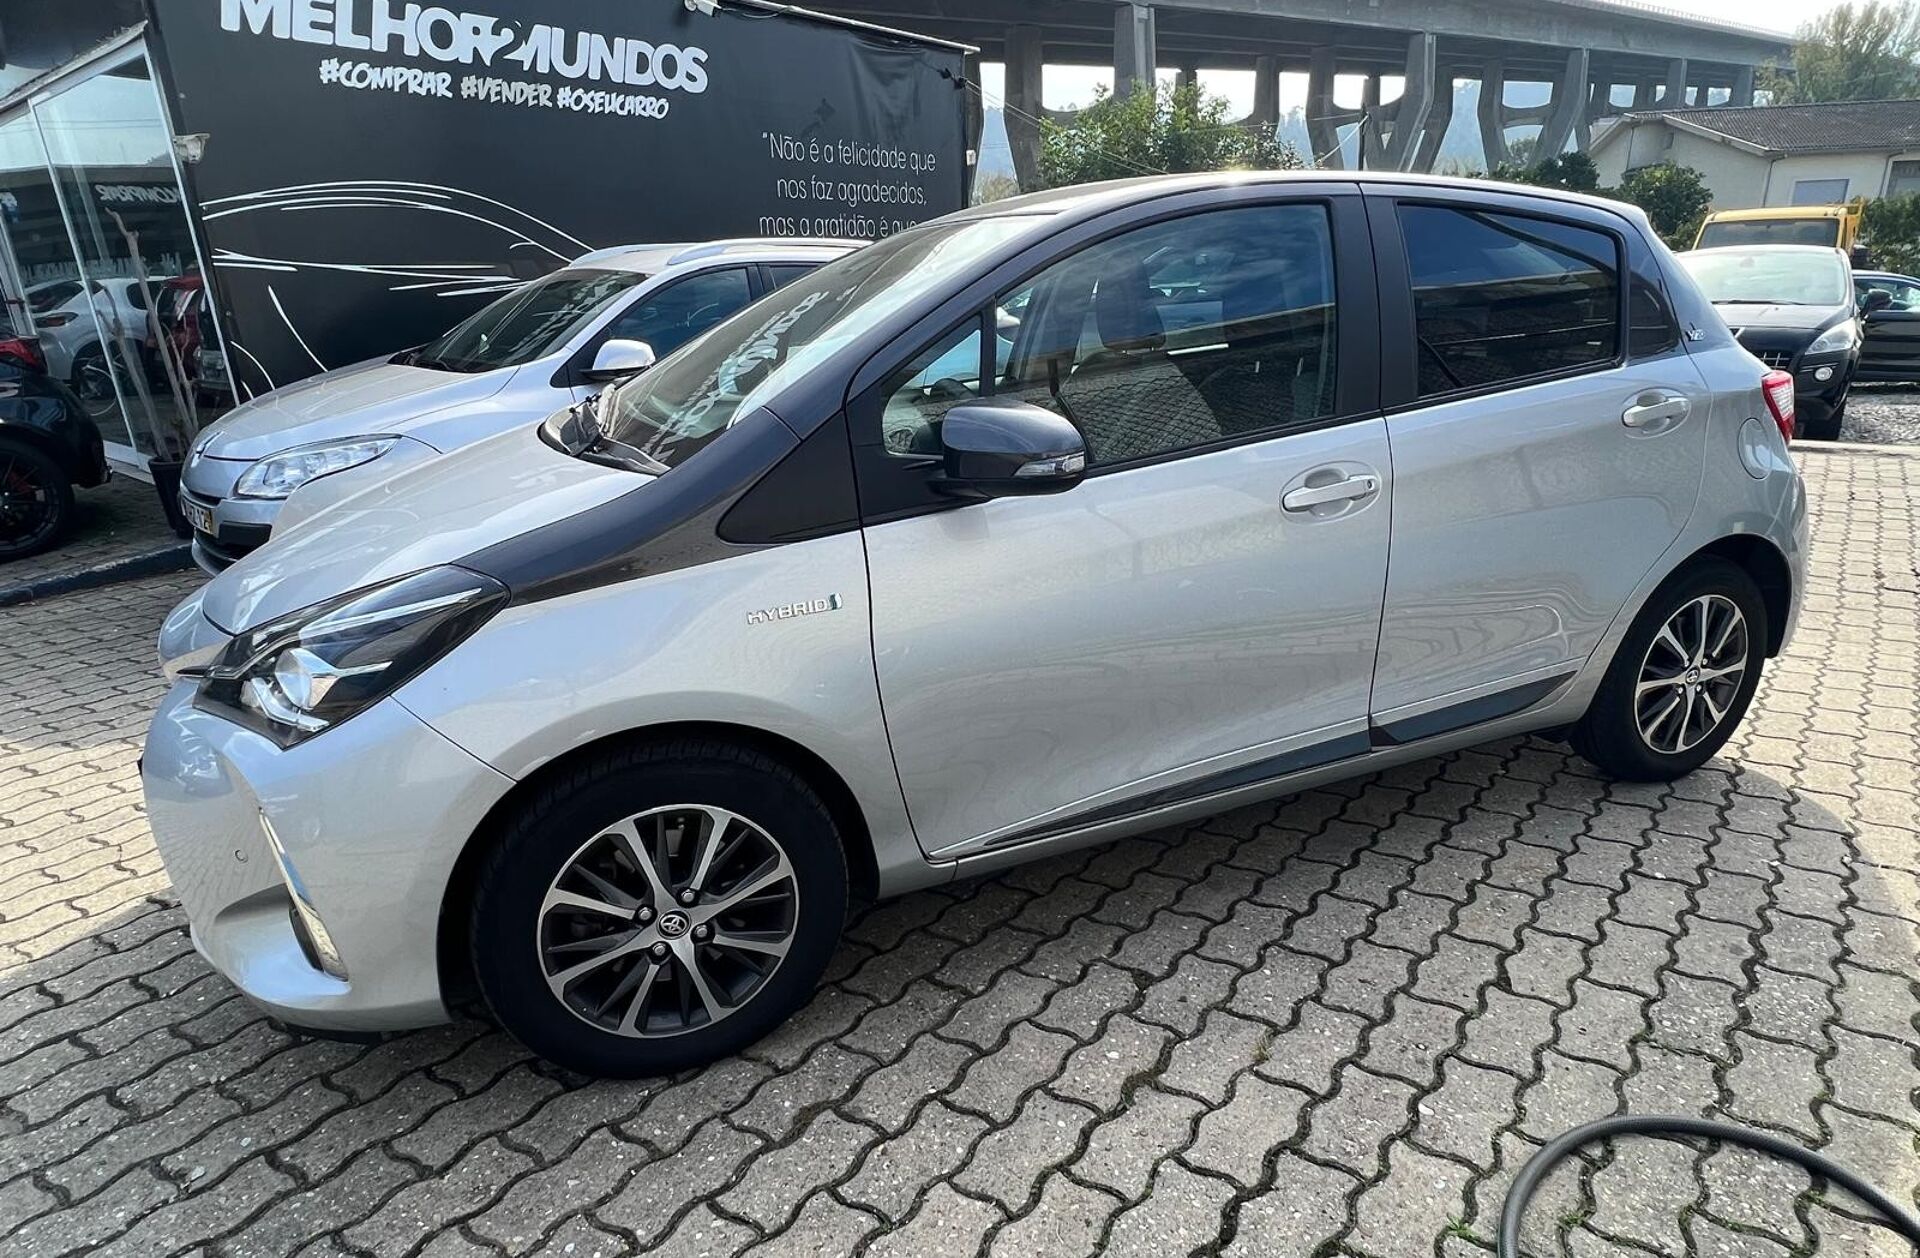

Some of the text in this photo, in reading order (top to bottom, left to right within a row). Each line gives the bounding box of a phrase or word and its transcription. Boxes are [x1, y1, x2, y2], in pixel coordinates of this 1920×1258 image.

[319, 57, 669, 119] #COMPRAR #VENDER #OSEUCARRO
[809, 138, 819, 163] é
[824, 144, 834, 163] a
[838, 138, 907, 169] felicidade
[910, 153, 936, 175] que
[777, 174, 927, 207] nos faz agradecidos,
[759, 216, 796, 236] mas
[800, 217, 810, 236] a
[814, 213, 876, 238] gratidão
[880, 215, 888, 238] é
[747, 599, 828, 624] HYBRID
